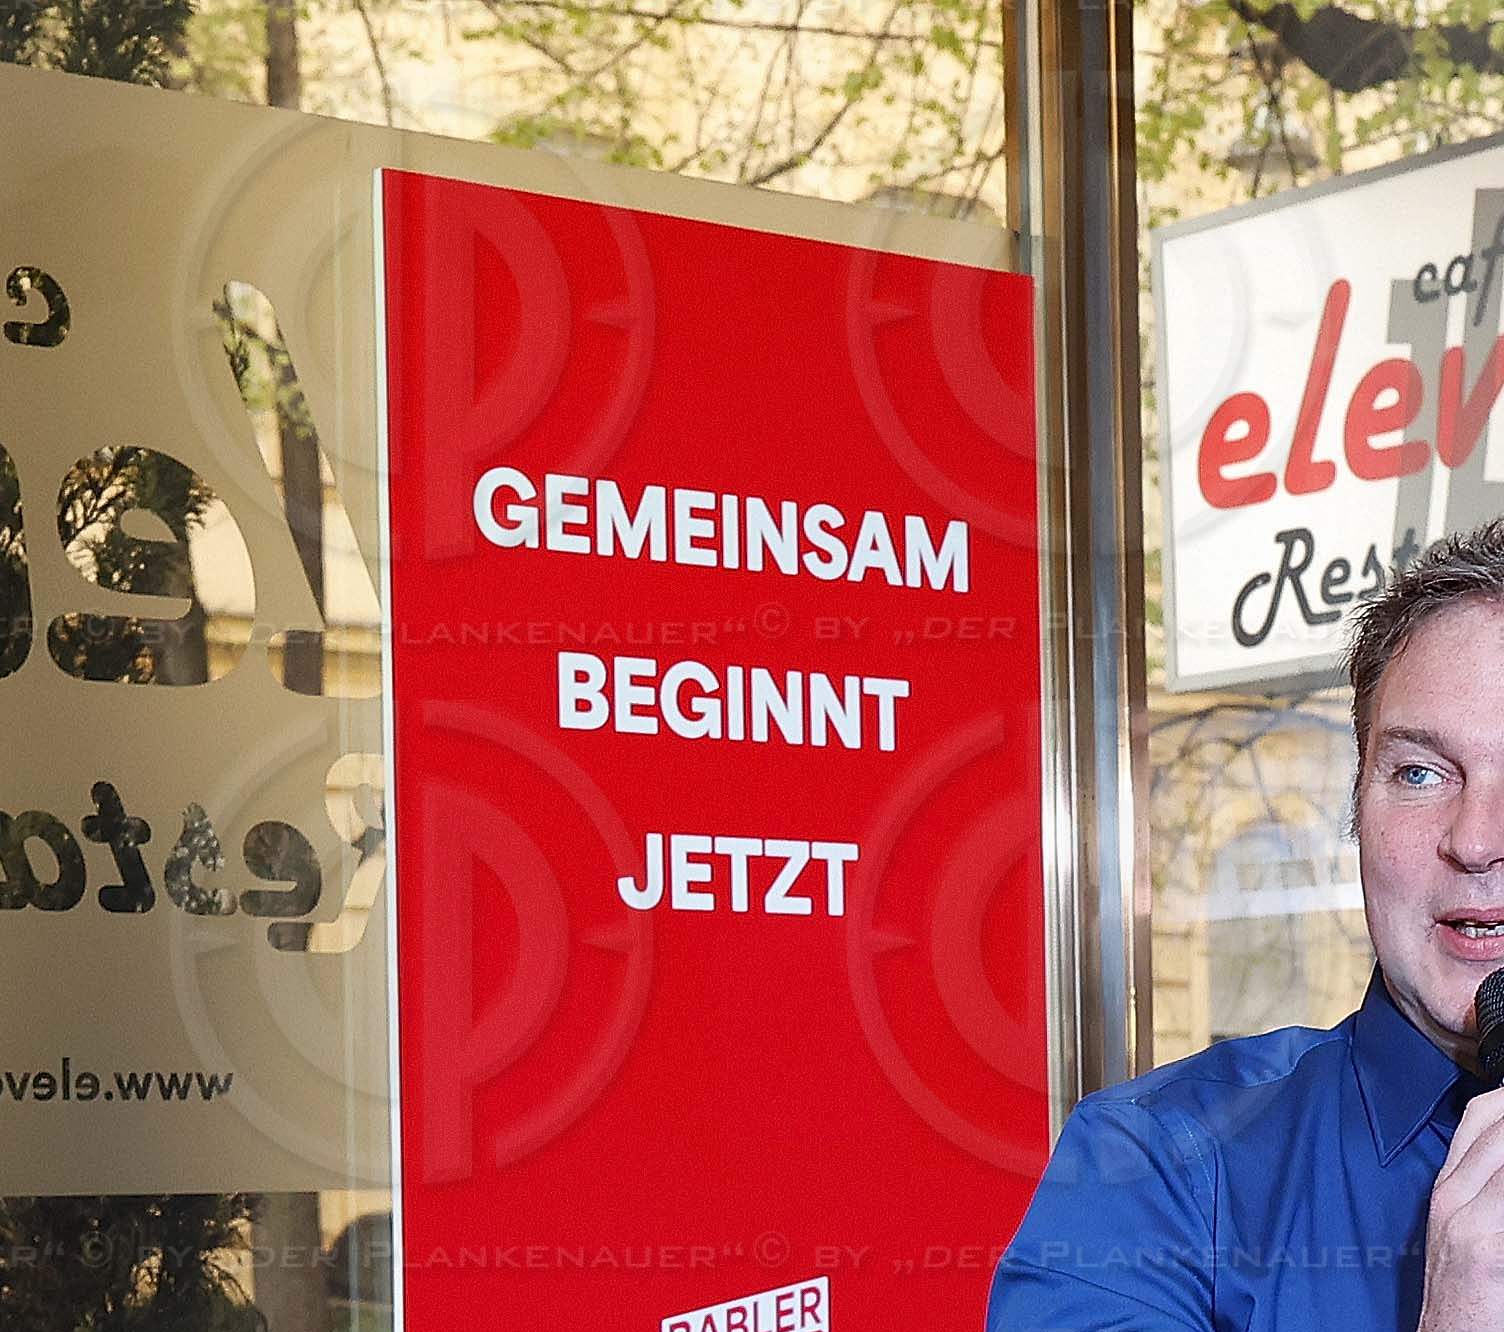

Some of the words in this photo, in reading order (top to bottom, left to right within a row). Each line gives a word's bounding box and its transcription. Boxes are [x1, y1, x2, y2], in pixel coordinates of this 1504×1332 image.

[473, 465, 969, 594] GEMEINSAM
[556, 650, 910, 752] BEGINNT
[616, 832, 859, 917] JETZT
